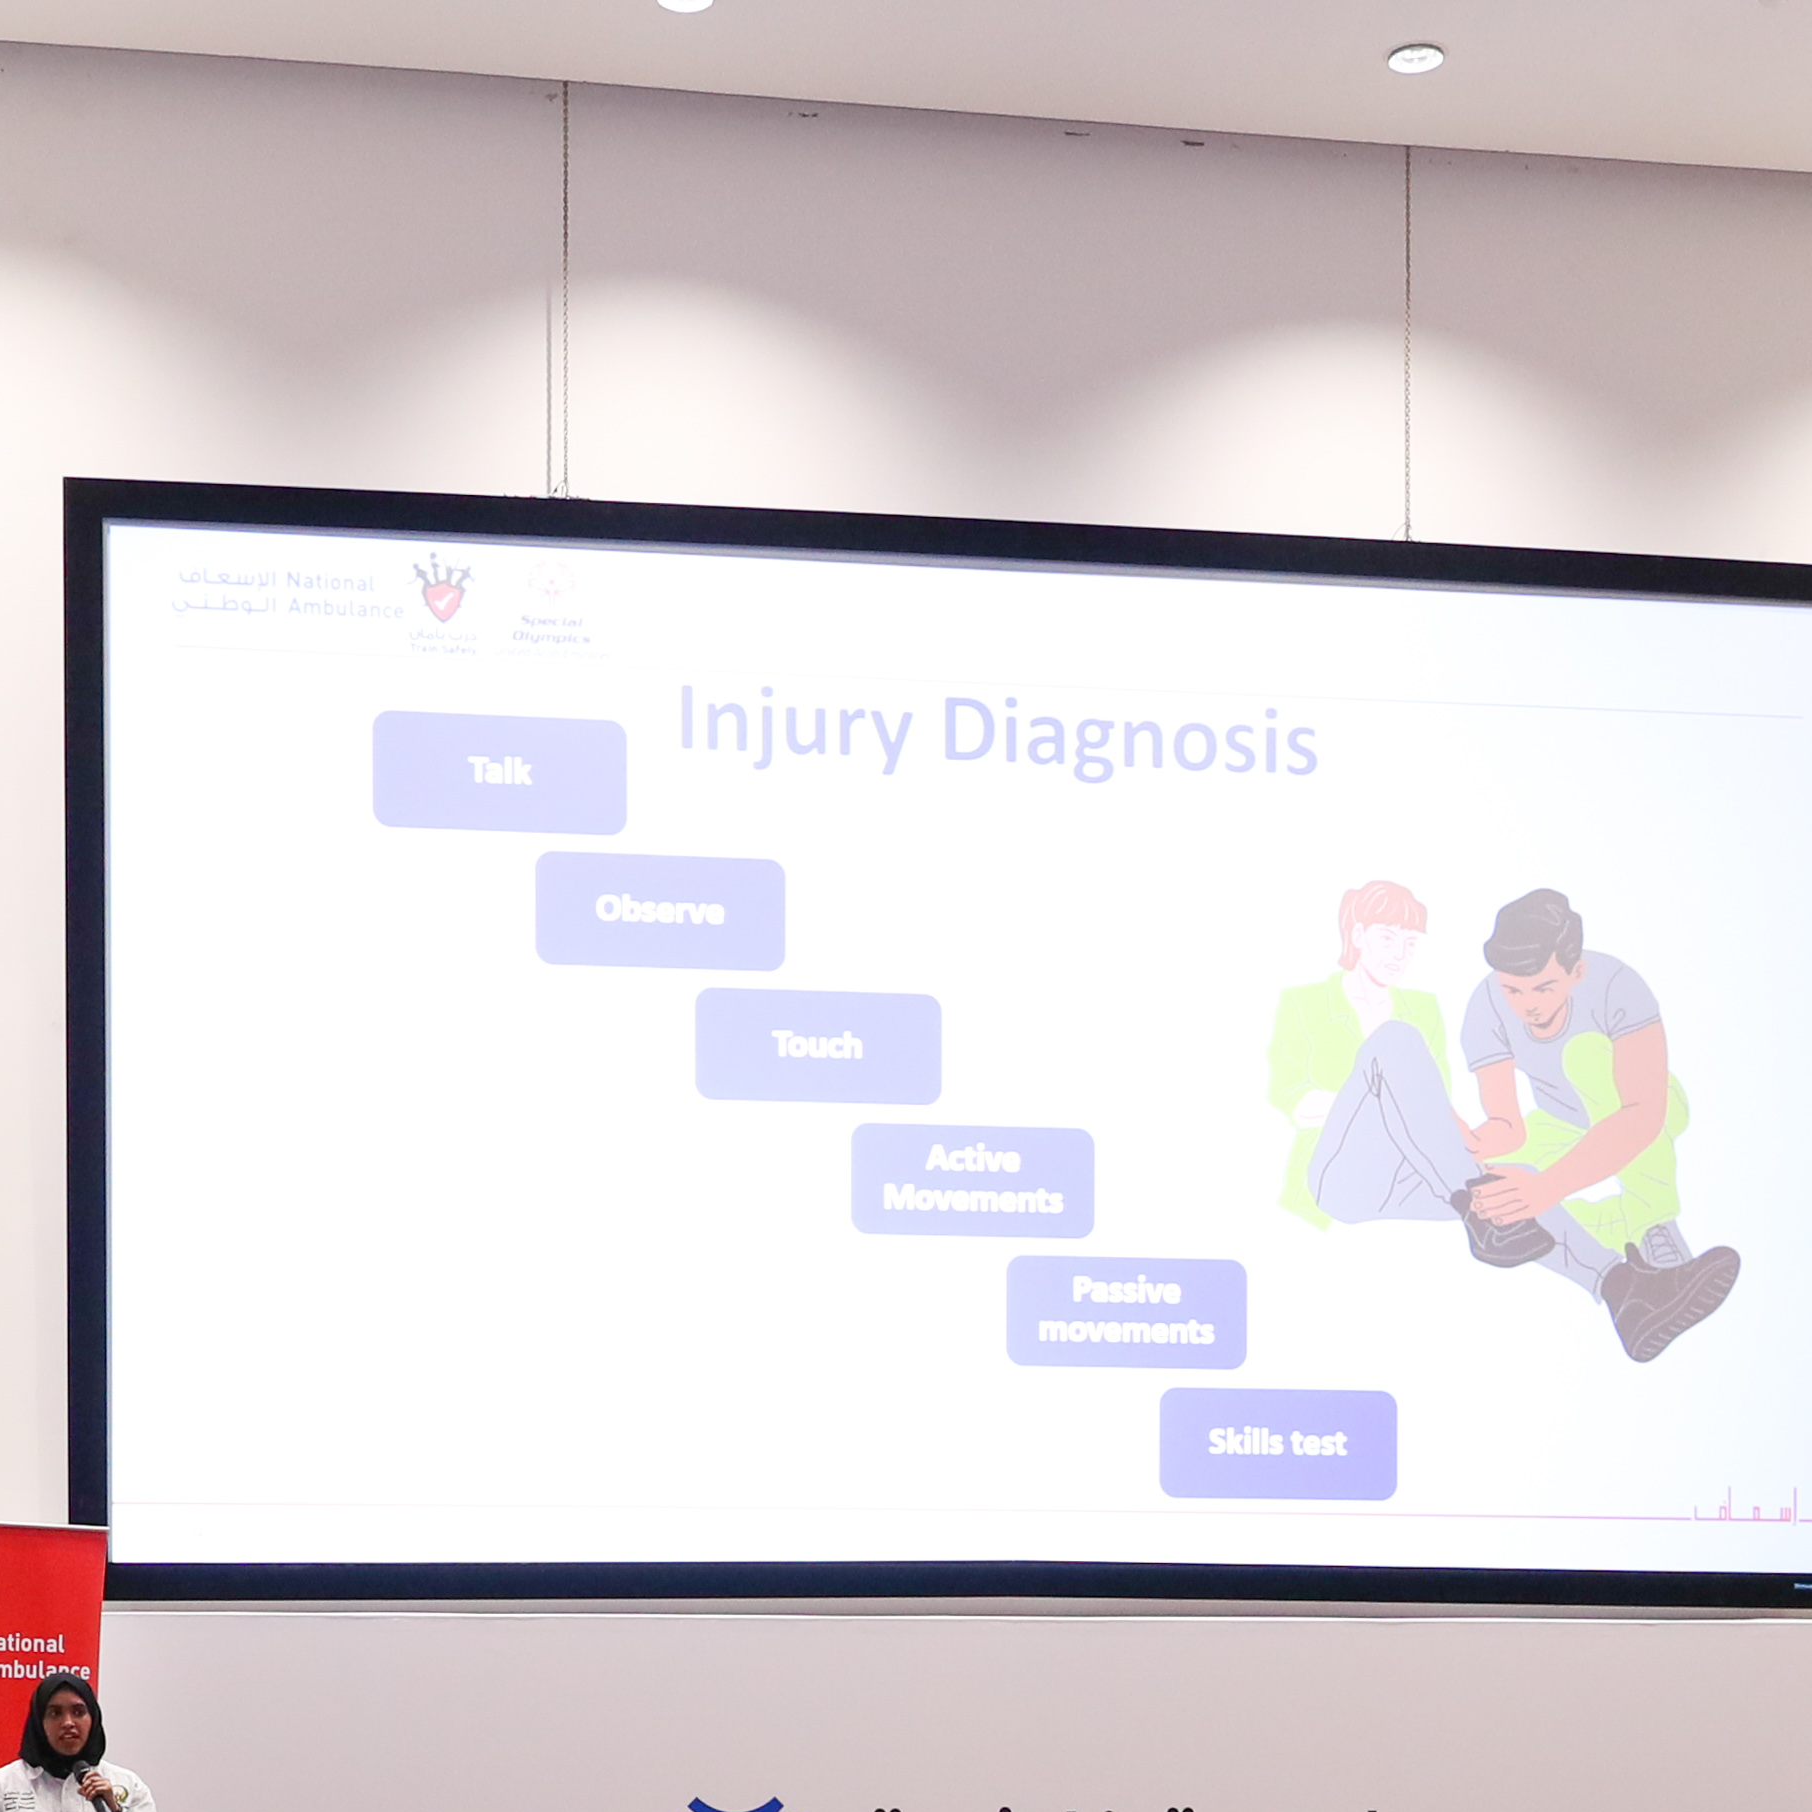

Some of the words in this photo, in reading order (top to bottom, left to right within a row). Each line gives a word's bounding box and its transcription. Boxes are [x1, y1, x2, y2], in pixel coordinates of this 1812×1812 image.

[178, 566, 276, 592] الإسعاف
[286, 571, 375, 593] National
[171, 593, 276, 619] الوطني
[287, 598, 405, 620] Ambulance
[520, 614, 583, 629] Special
[512, 630, 591, 646] Olympics
[680, 684, 913, 776] Injury
[944, 696, 1319, 784] Diagnosis
[467, 754, 533, 787] Talk
[594, 892, 727, 926] Observe
[771, 1028, 864, 1061] Touch
[925, 1142, 1022, 1174] Active
[882, 1183, 1064, 1216] Movements
[1072, 1275, 1182, 1307] Passive
[1038, 1316, 1216, 1348] movements
[1208, 1427, 1284, 1458] Skills
[1290, 1429, 1348, 1459] test
